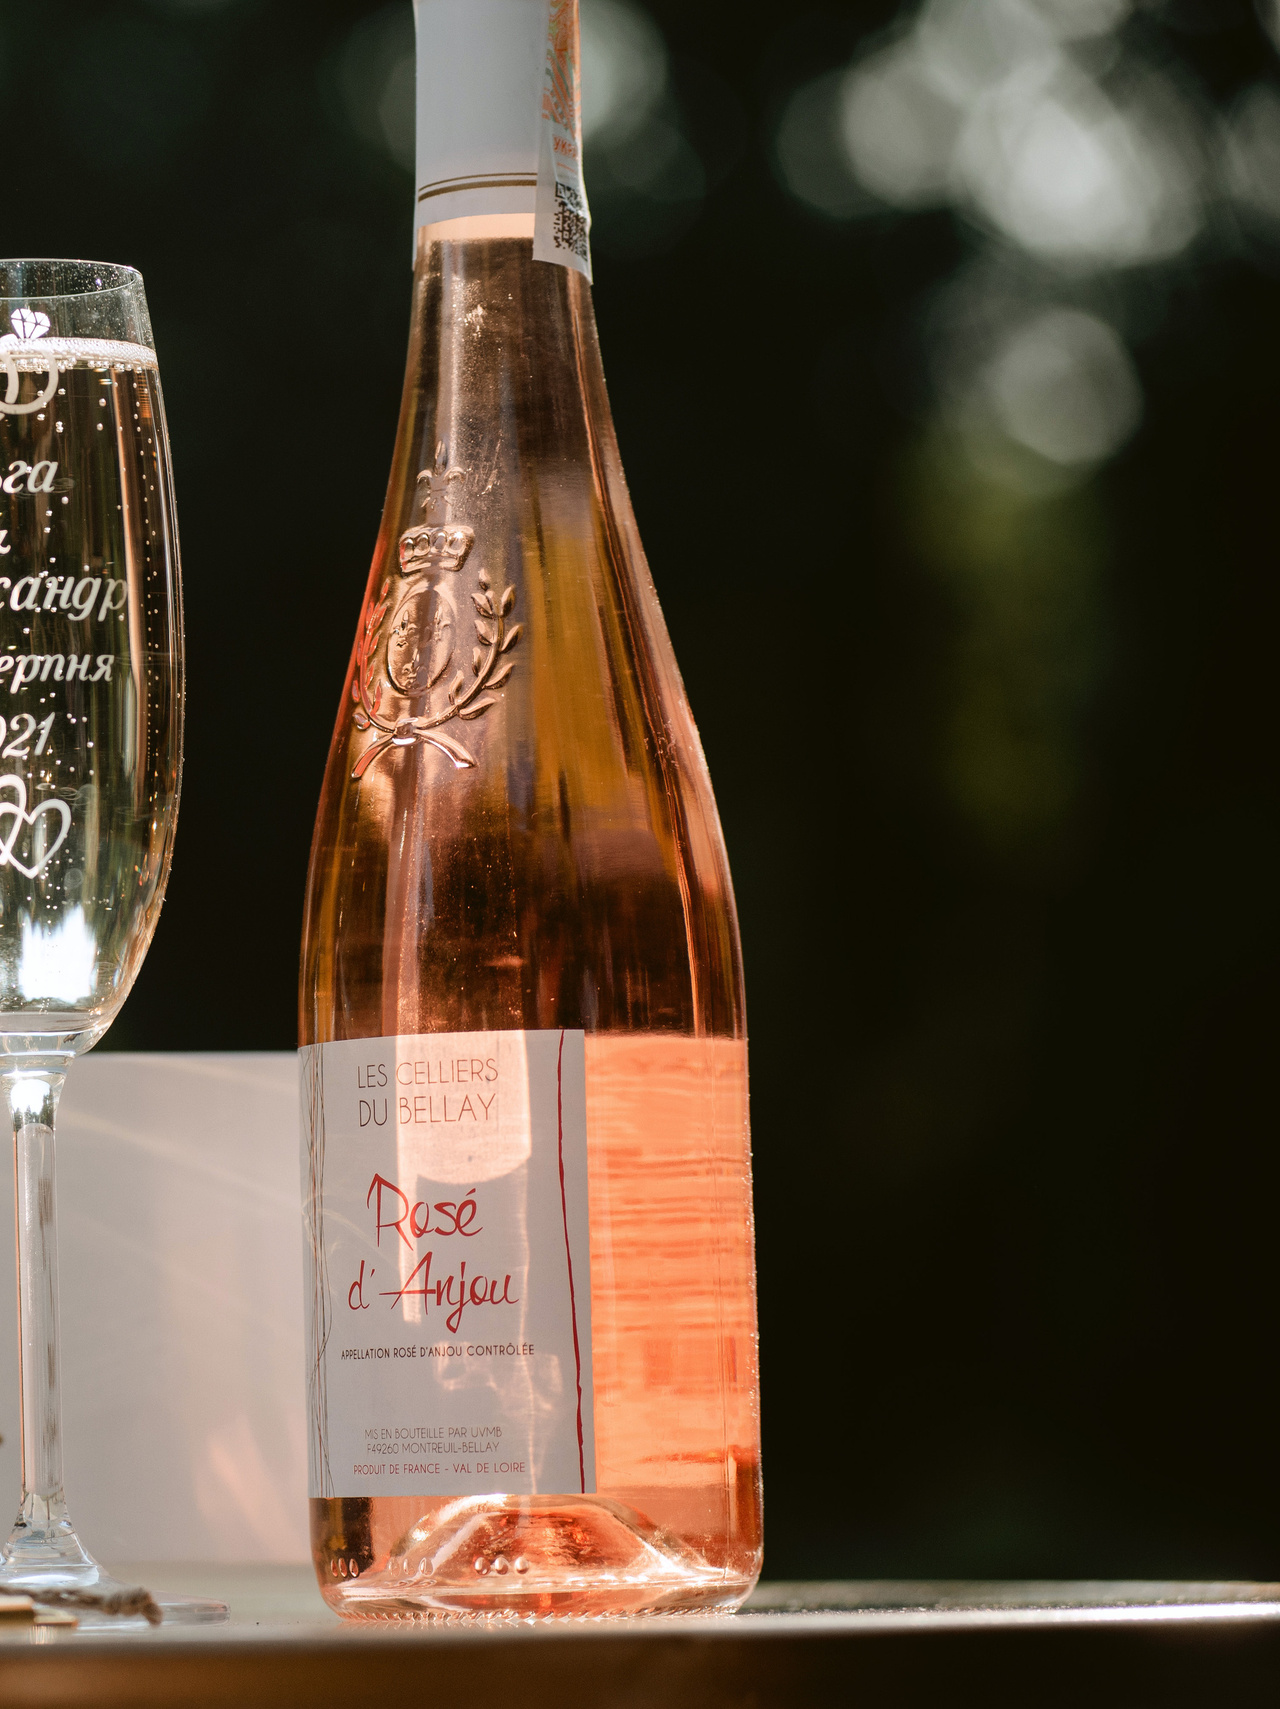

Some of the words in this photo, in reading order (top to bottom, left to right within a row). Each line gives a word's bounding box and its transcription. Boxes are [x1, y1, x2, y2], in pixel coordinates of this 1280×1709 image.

[357, 1063, 389, 1089] LES
[395, 1058, 499, 1086] CELLIERS
[359, 1098, 389, 1127] DU
[399, 1093, 497, 1125] BELLAY
[367, 1173, 484, 1252] Rosé
[341, 1348, 391, 1361] APPELLATION
[393, 1344, 418, 1359] ROSÉ
[420, 1345, 463, 1358] D'ANJOU
[466, 1342, 535, 1357] CONTRÔLÉE
[364, 1428, 379, 1440] MIS
[381, 1428, 393, 1440] EN
[394, 1427, 445, 1440] BOUTEILLE
[448, 1427, 468, 1438] PAR
[471, 1426, 503, 1438] UVMB
[367, 1442, 400, 1455] F49260
[402, 1441, 500, 1454] MONTREUIL-BELLAY
[353, 1463, 387, 1476] PRODUIT
[389, 1463, 400, 1475] DE
[403, 1462, 441, 1474] FRANCE
[452, 1462, 473, 1474] VAL
[476, 1462, 490, 1474] DE
[493, 1461, 527, 1474] LOIRE
